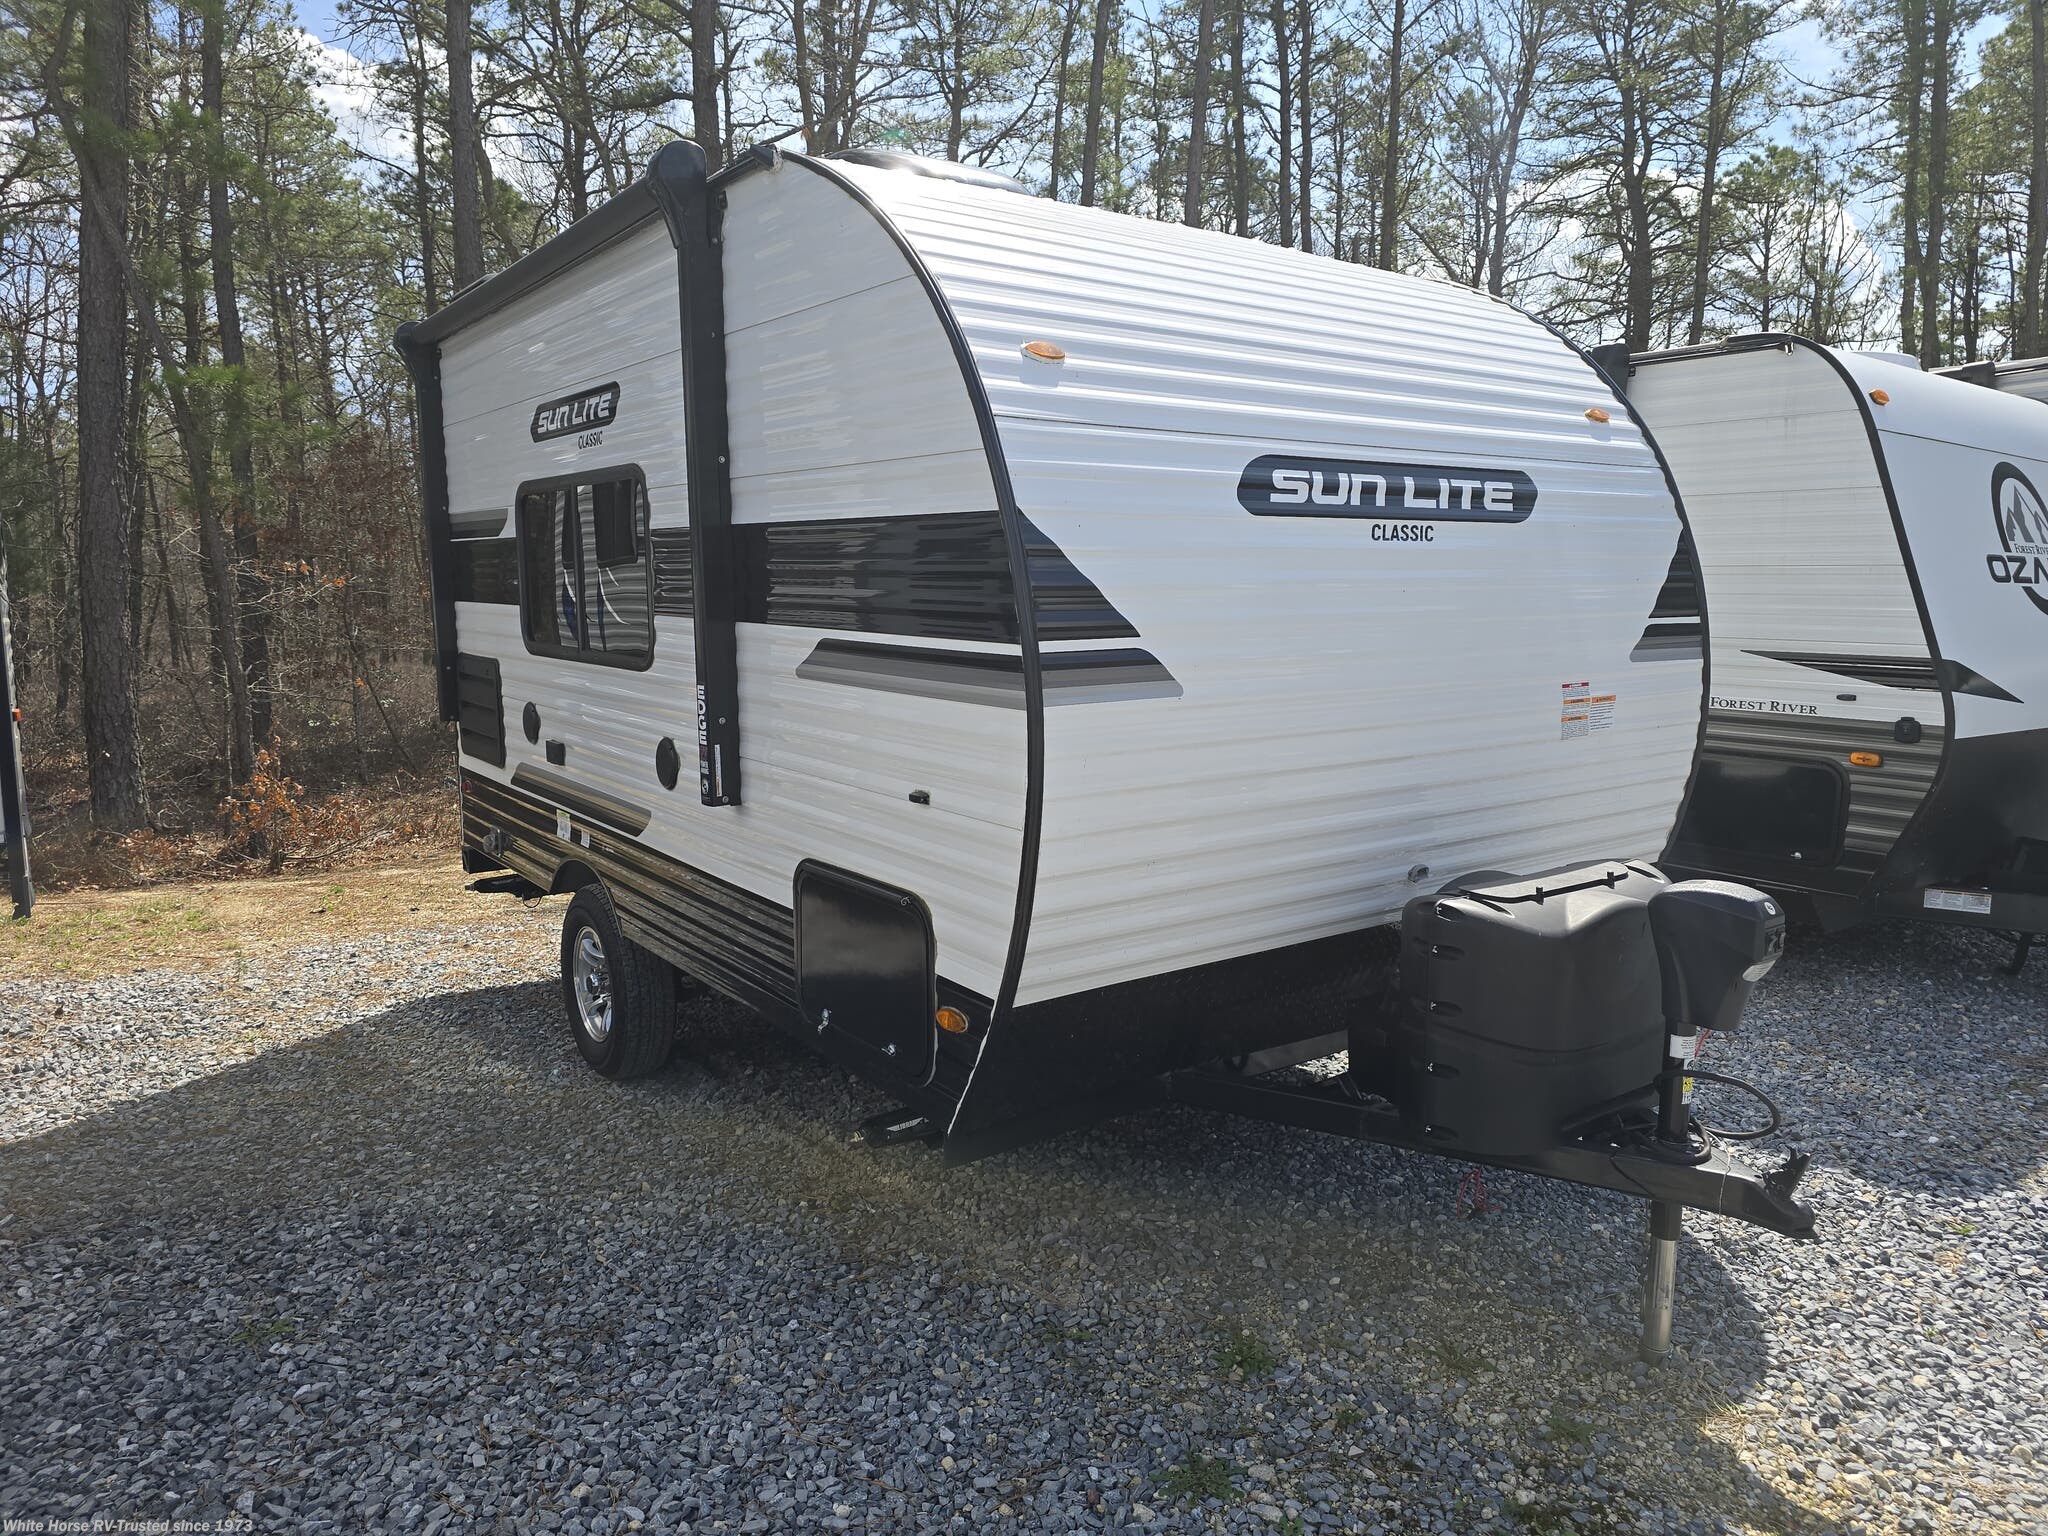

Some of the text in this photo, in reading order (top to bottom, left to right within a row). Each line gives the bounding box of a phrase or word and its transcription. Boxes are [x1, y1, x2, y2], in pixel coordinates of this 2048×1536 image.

[537, 393, 612, 433] SUN LITE
[578, 431, 603, 449] CLASSIC
[1270, 469, 1514, 511] SUN LITE
[1371, 523, 1434, 542] CLASSIC
